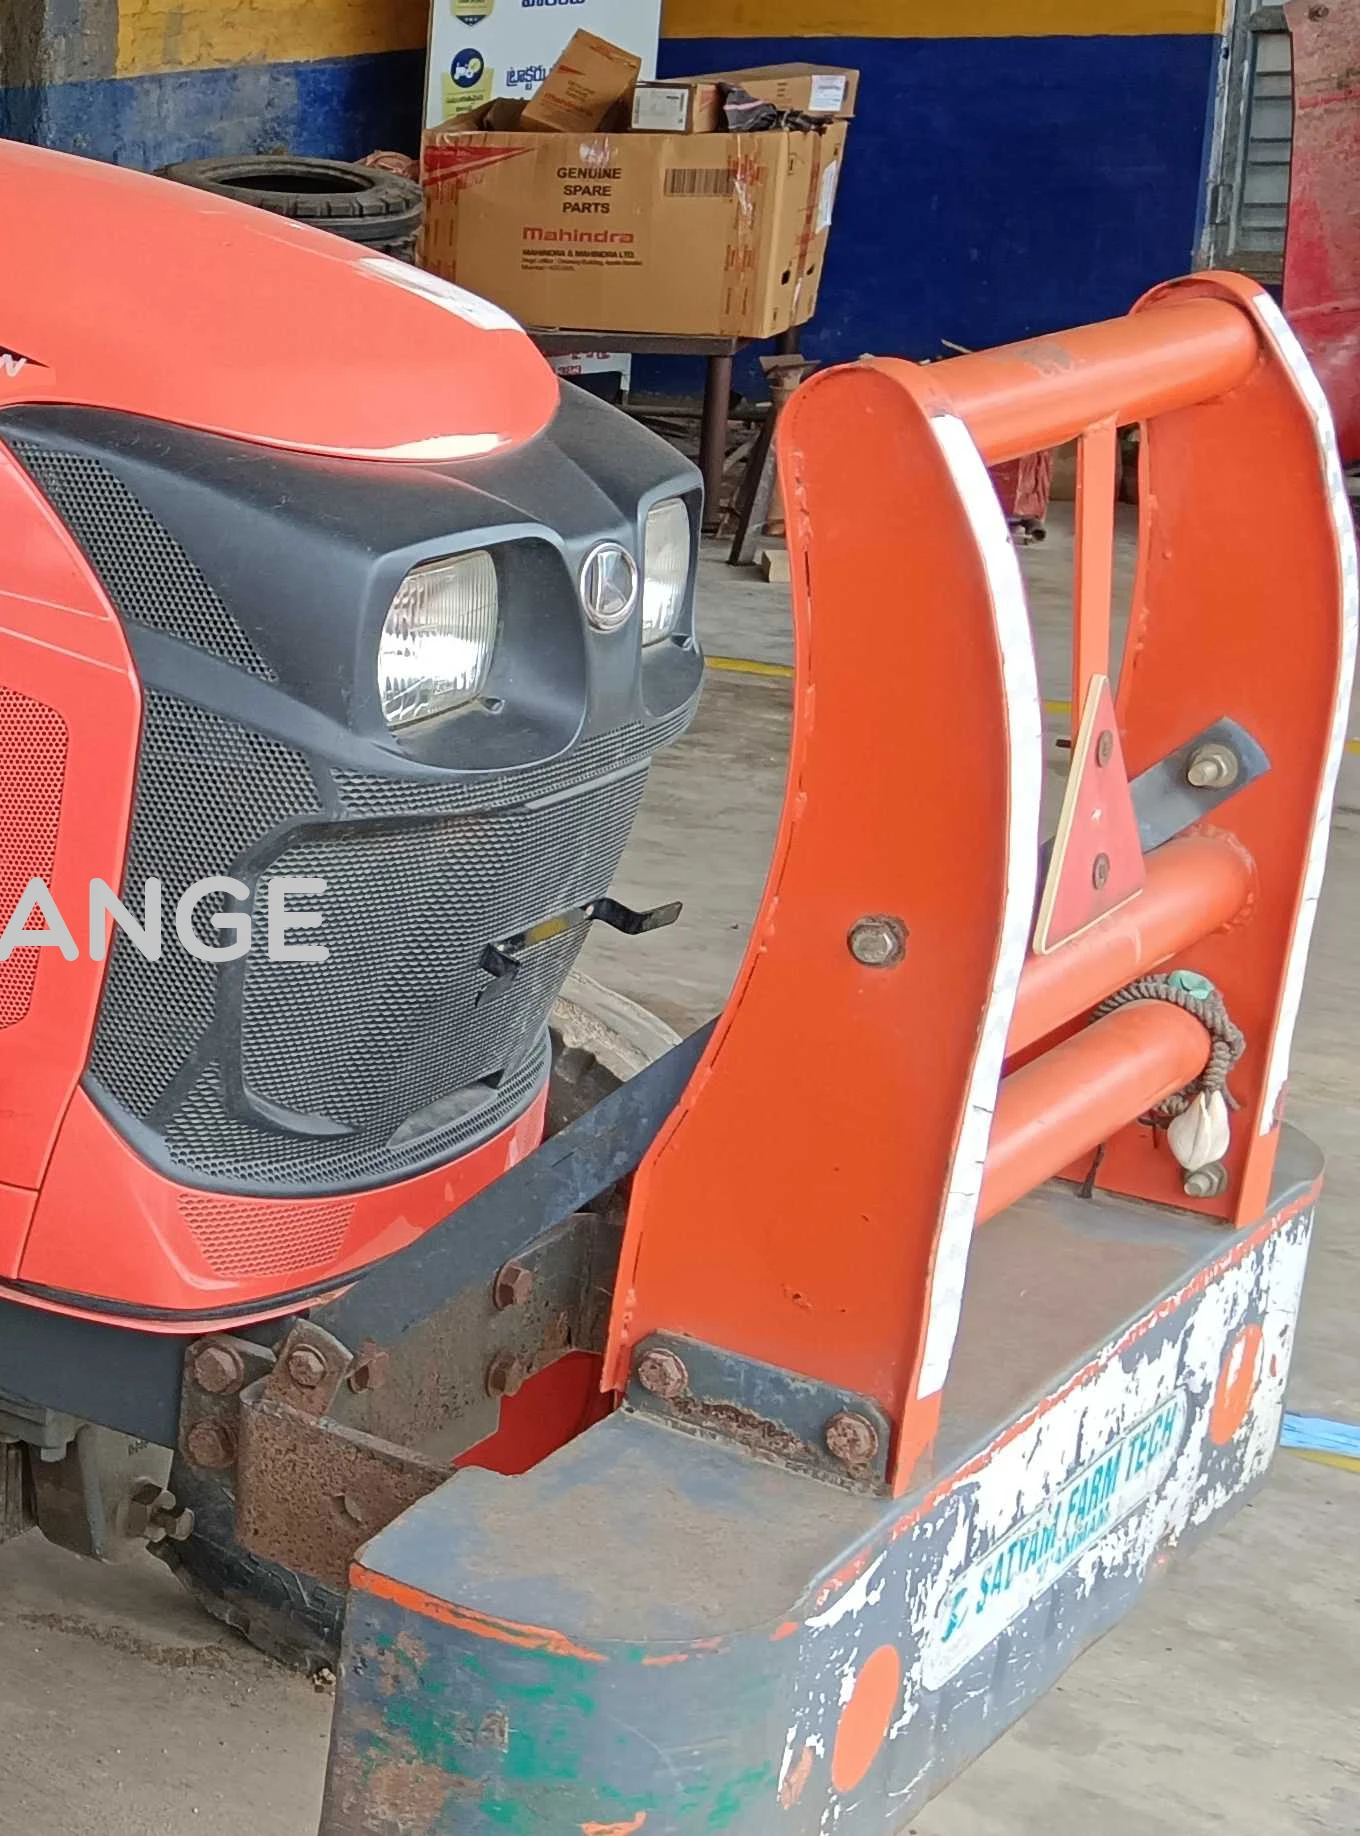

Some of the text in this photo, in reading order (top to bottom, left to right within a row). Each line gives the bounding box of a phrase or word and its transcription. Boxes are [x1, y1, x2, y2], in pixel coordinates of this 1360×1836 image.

[556, 166, 623, 180] GENUINE
[563, 184, 612, 197] SPARE
[562, 201, 611, 214] PARTS
[1066, 1443, 1123, 1537] FARM
[1124, 1401, 1179, 1482] TECH
